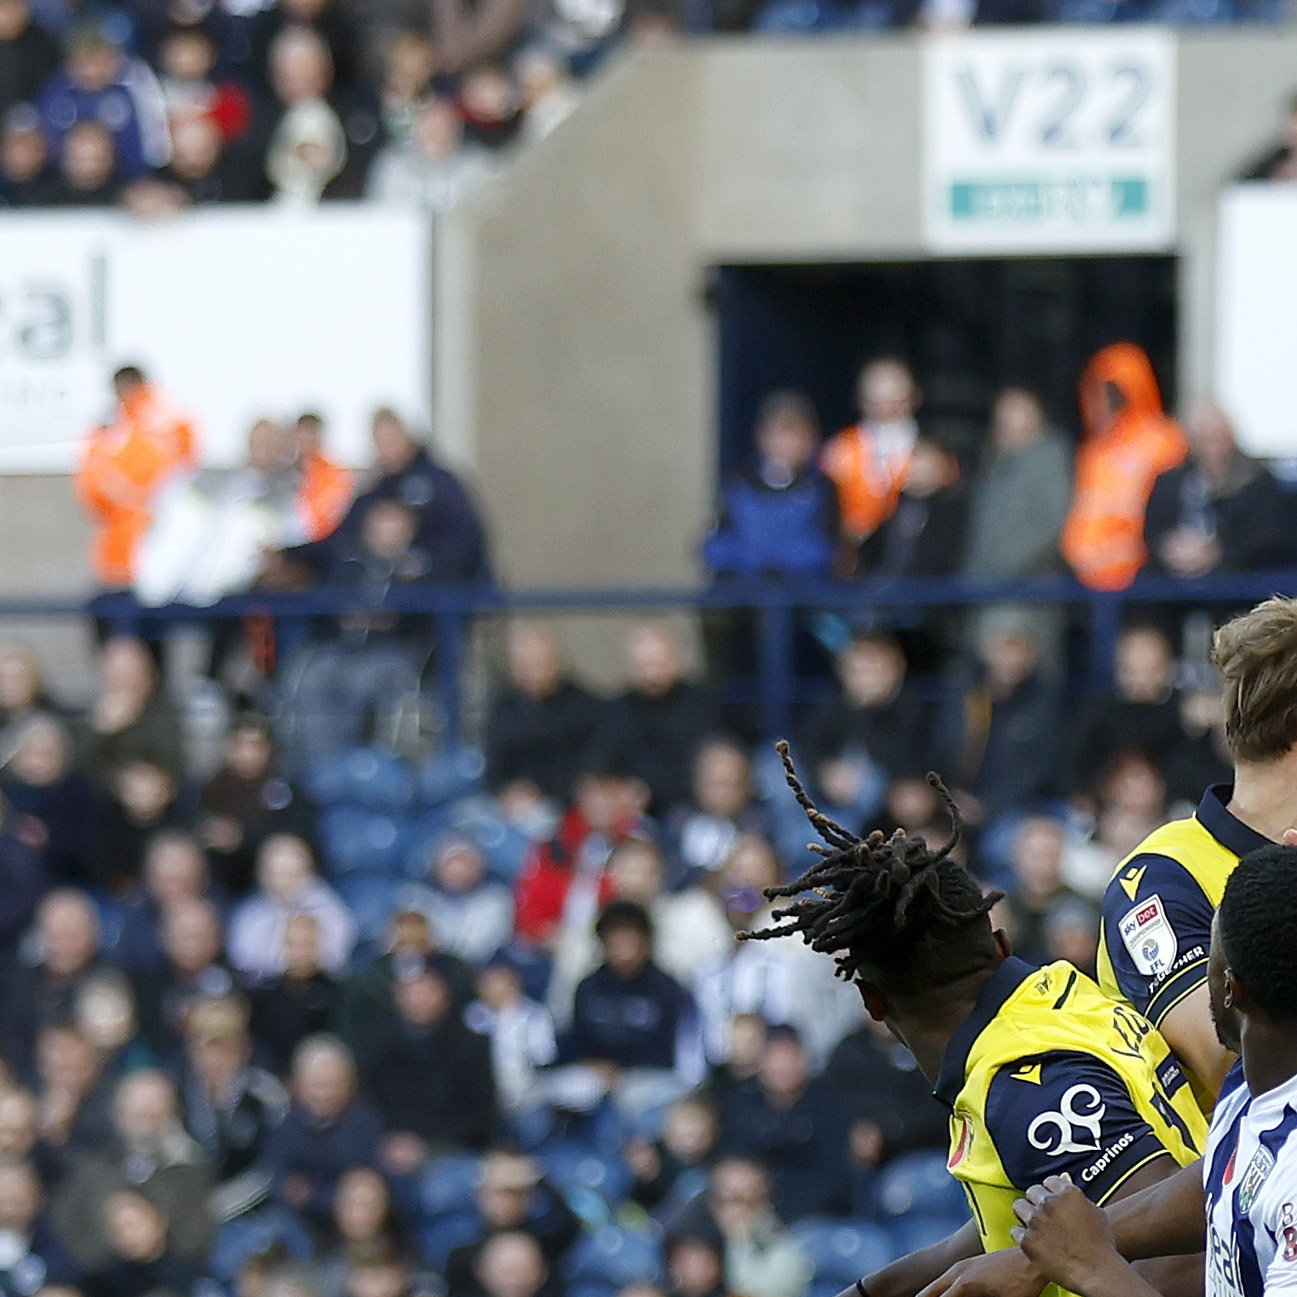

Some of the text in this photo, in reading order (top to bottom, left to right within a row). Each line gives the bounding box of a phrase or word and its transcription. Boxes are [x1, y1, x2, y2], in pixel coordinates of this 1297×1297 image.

[954, 56, 1152, 150] V22
[0, 254, 108, 362] al
[1124, 919, 1137, 937] sky
[1149, 959, 1166, 975] EFL
[1081, 1131, 1135, 1183] Caprinos
